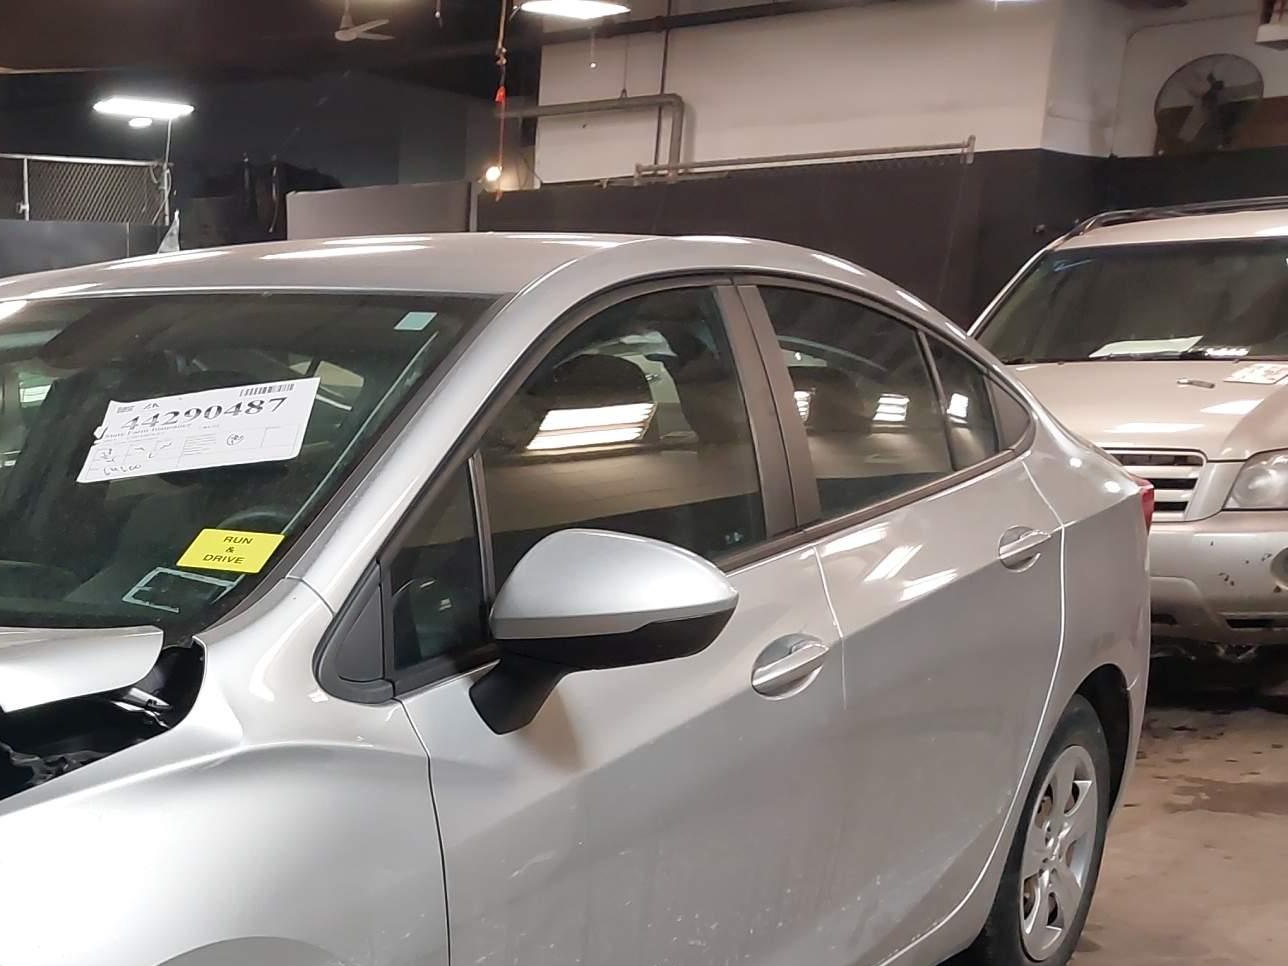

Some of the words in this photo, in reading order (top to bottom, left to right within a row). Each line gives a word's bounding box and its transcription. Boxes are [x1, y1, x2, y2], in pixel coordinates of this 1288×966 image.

[121, 397, 287, 430] 44290487
[223, 535, 254, 545] RUN
[225, 546, 235, 554] &
[202, 553, 245, 565] DRIVE
